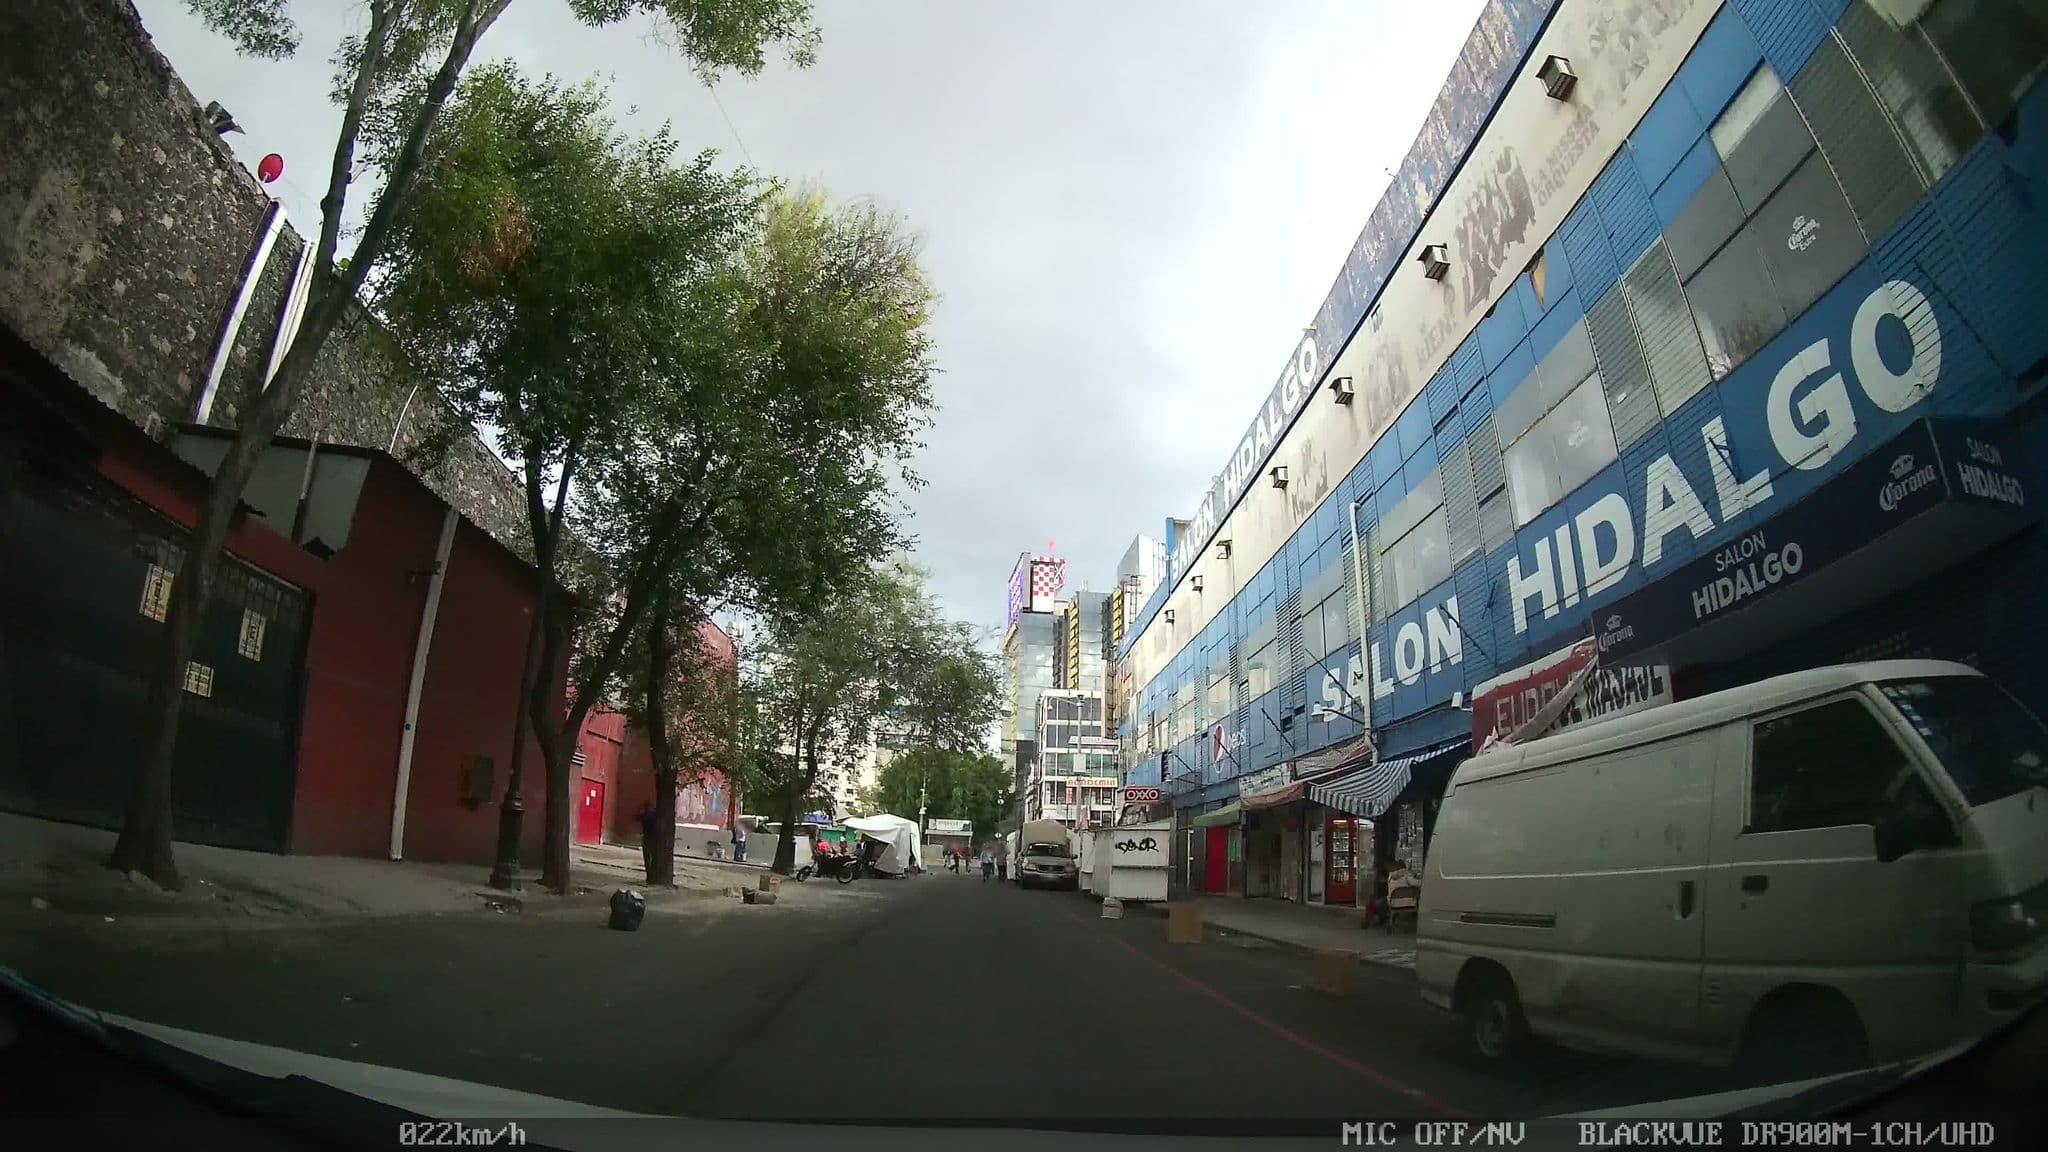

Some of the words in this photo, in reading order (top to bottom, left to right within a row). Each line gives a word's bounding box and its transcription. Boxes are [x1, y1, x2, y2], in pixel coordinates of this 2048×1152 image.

[1788, 218, 1820, 250] Corona
[1222, 337, 1318, 511] HIDALGO
[1322, 594, 1462, 722] SALON
[1507, 279, 1942, 635] HIDALGO
[1880, 464, 1937, 511] Corona
[1956, 462, 2025, 506] HIDALGO
[1715, 530, 1767, 573] SALON
[1692, 542, 1804, 619] HIDALGO
[1599, 624, 1635, 653] Corona
[1126, 789, 1159, 800] OXXO
